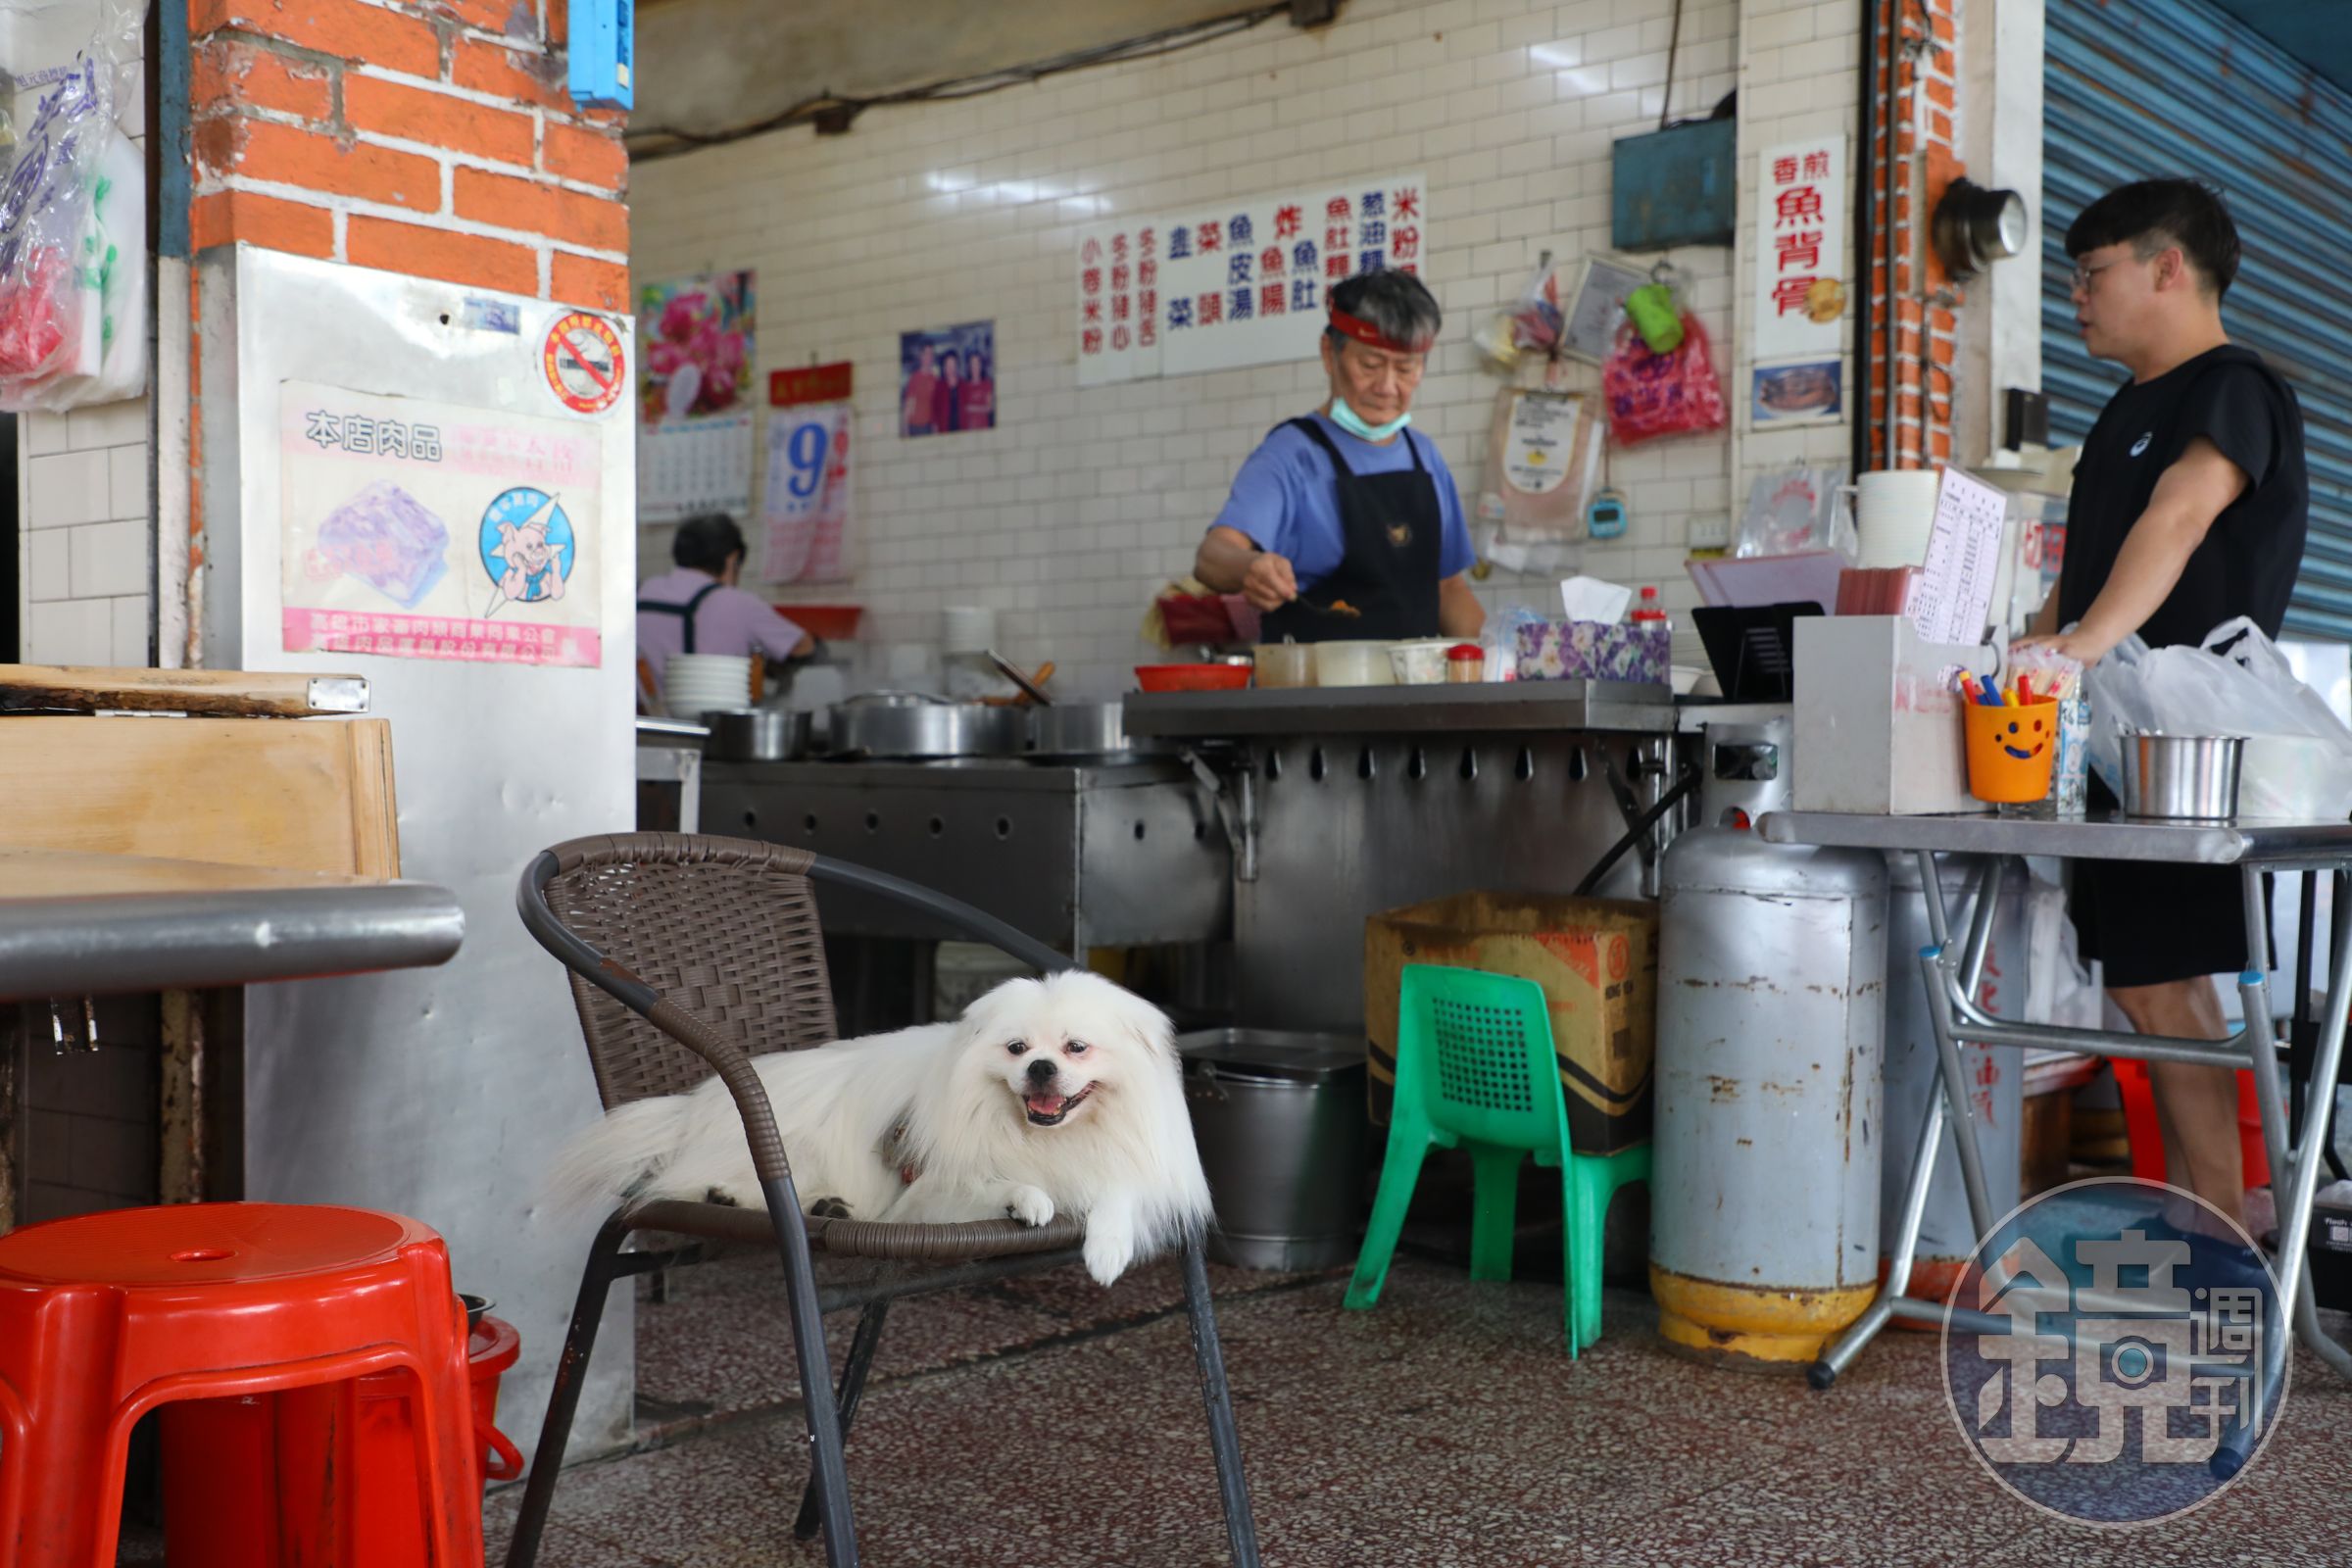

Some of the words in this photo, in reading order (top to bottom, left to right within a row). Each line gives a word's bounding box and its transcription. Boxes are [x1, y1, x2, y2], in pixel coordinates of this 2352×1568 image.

[1774, 150, 1830, 185] 香煎
[1228, 213, 1253, 321] 魚皮湯
[1274, 203, 1303, 241] 炸
[1325, 195, 1352, 312] 魚肚麵
[1392, 186, 1421, 278] 米粉
[1772, 186, 1825, 318] 魚背骨
[1197, 220, 1223, 326] 菜頭
[305, 409, 443, 463] 本店肉品
[787, 421, 829, 499] 9
